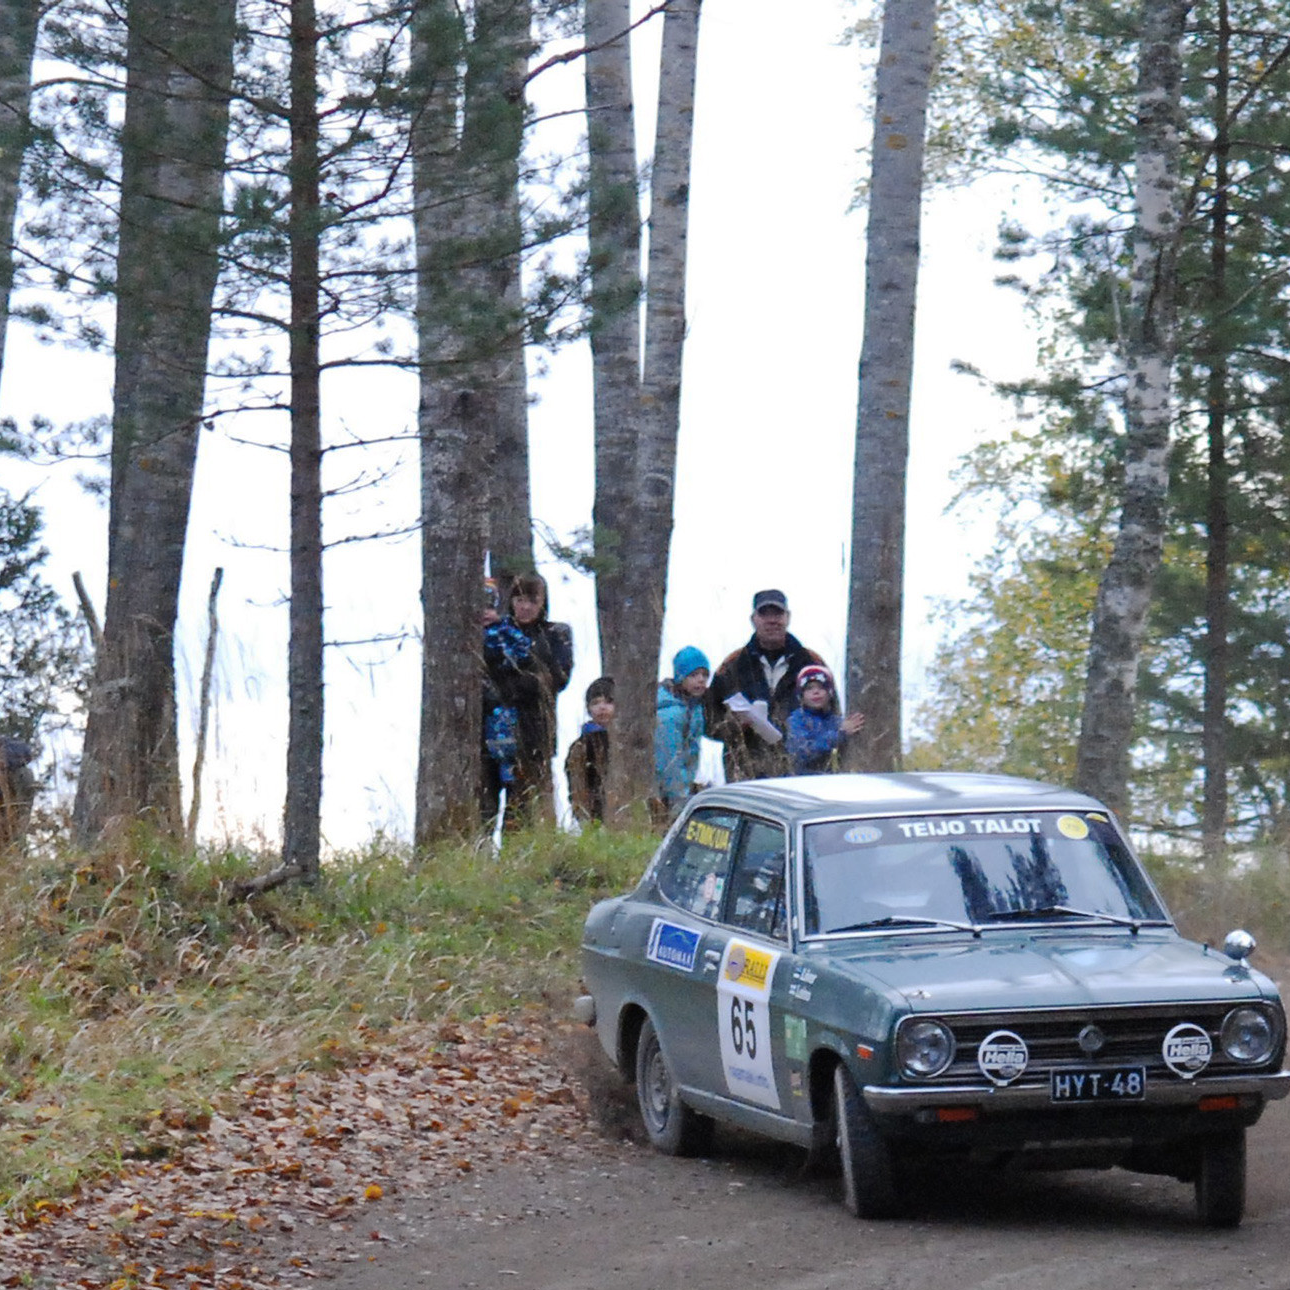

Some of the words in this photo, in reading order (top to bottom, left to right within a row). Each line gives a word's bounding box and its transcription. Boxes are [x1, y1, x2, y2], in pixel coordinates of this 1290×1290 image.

[899, 819, 966, 838] TEIJO
[970, 818, 1042, 834] TALOT
[731, 996, 757, 1060] 65
[984, 1051, 1025, 1064] Hella
[1169, 1043, 1209, 1057] Hella
[1054, 1071, 1142, 1098] HYT-48
